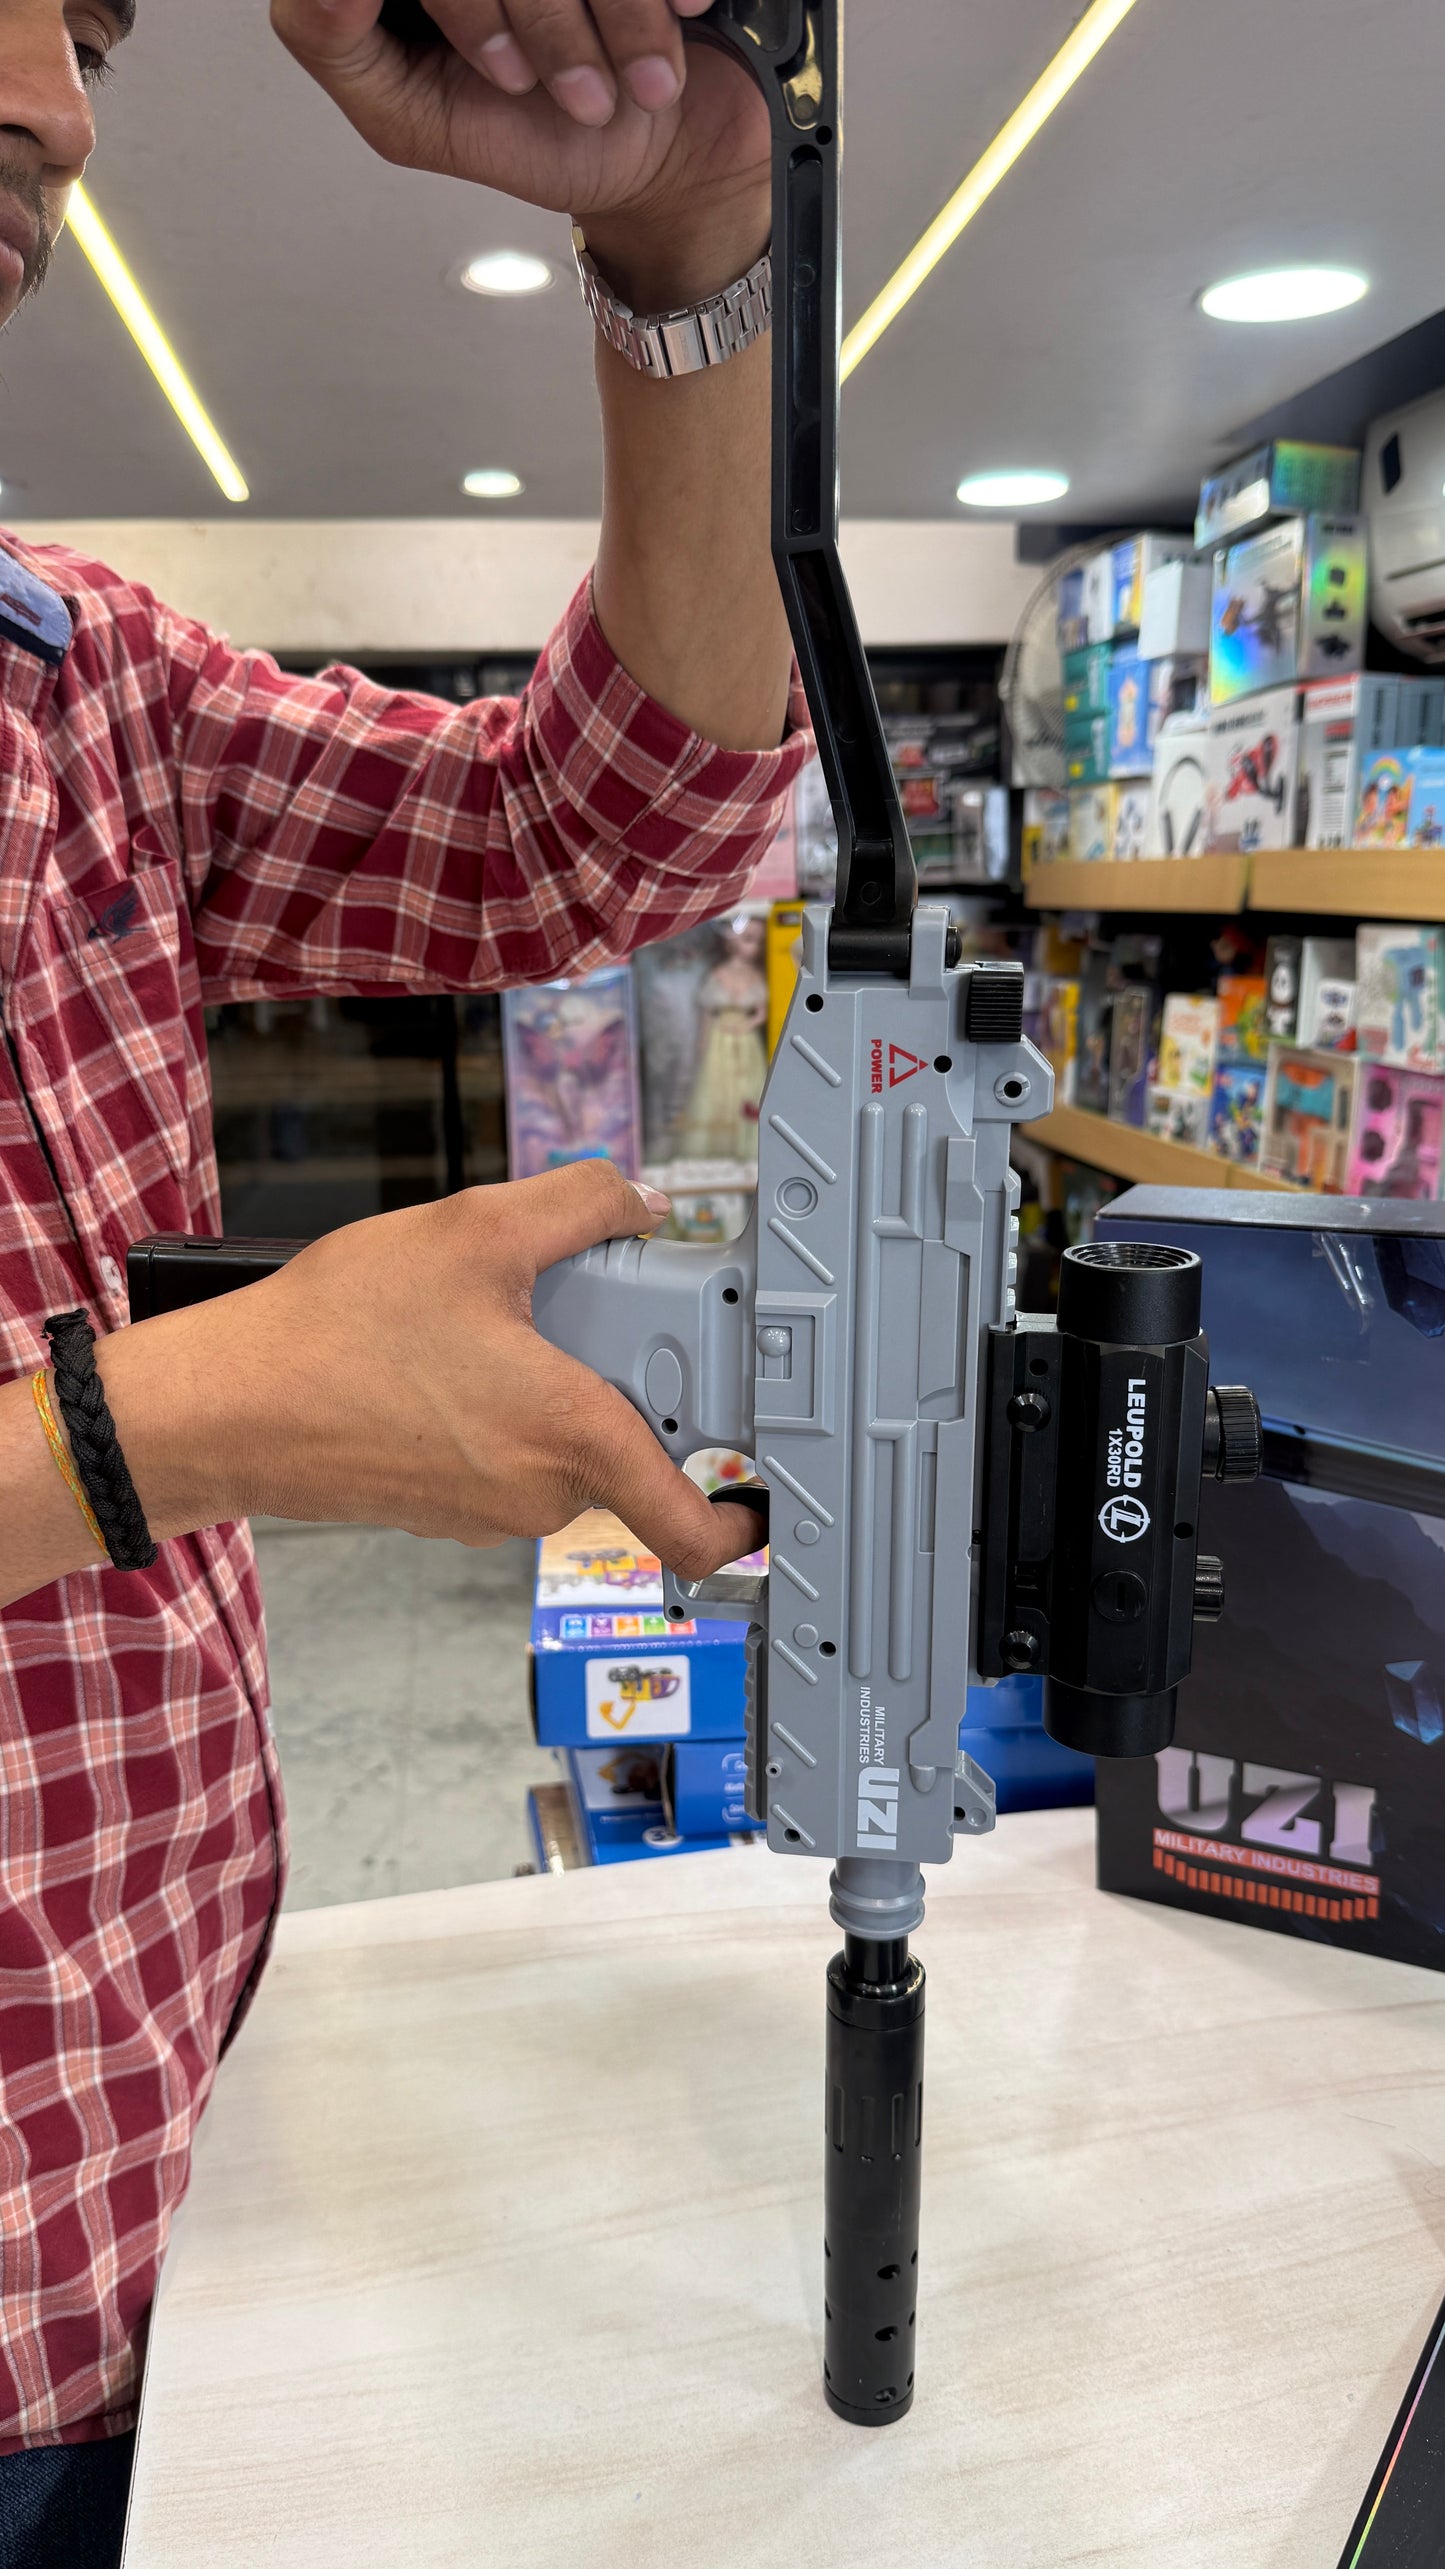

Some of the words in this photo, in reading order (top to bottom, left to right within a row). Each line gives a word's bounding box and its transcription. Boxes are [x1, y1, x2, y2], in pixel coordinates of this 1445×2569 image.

[870, 1039, 882, 1094] POWER
[1106, 1427, 1123, 1488] 1X30RD
[1123, 1378, 1147, 1489] LEUPOLD
[859, 1686, 871, 1764] INDUSTRIES
[874, 1705, 885, 1765] MILITARY
[857, 1766, 900, 1850] UZI
[1154, 1746, 1377, 1867] UZI
[1154, 1829, 1246, 1863] MILITARY
[1251, 1852, 1378, 1893] INDUSTRIES
